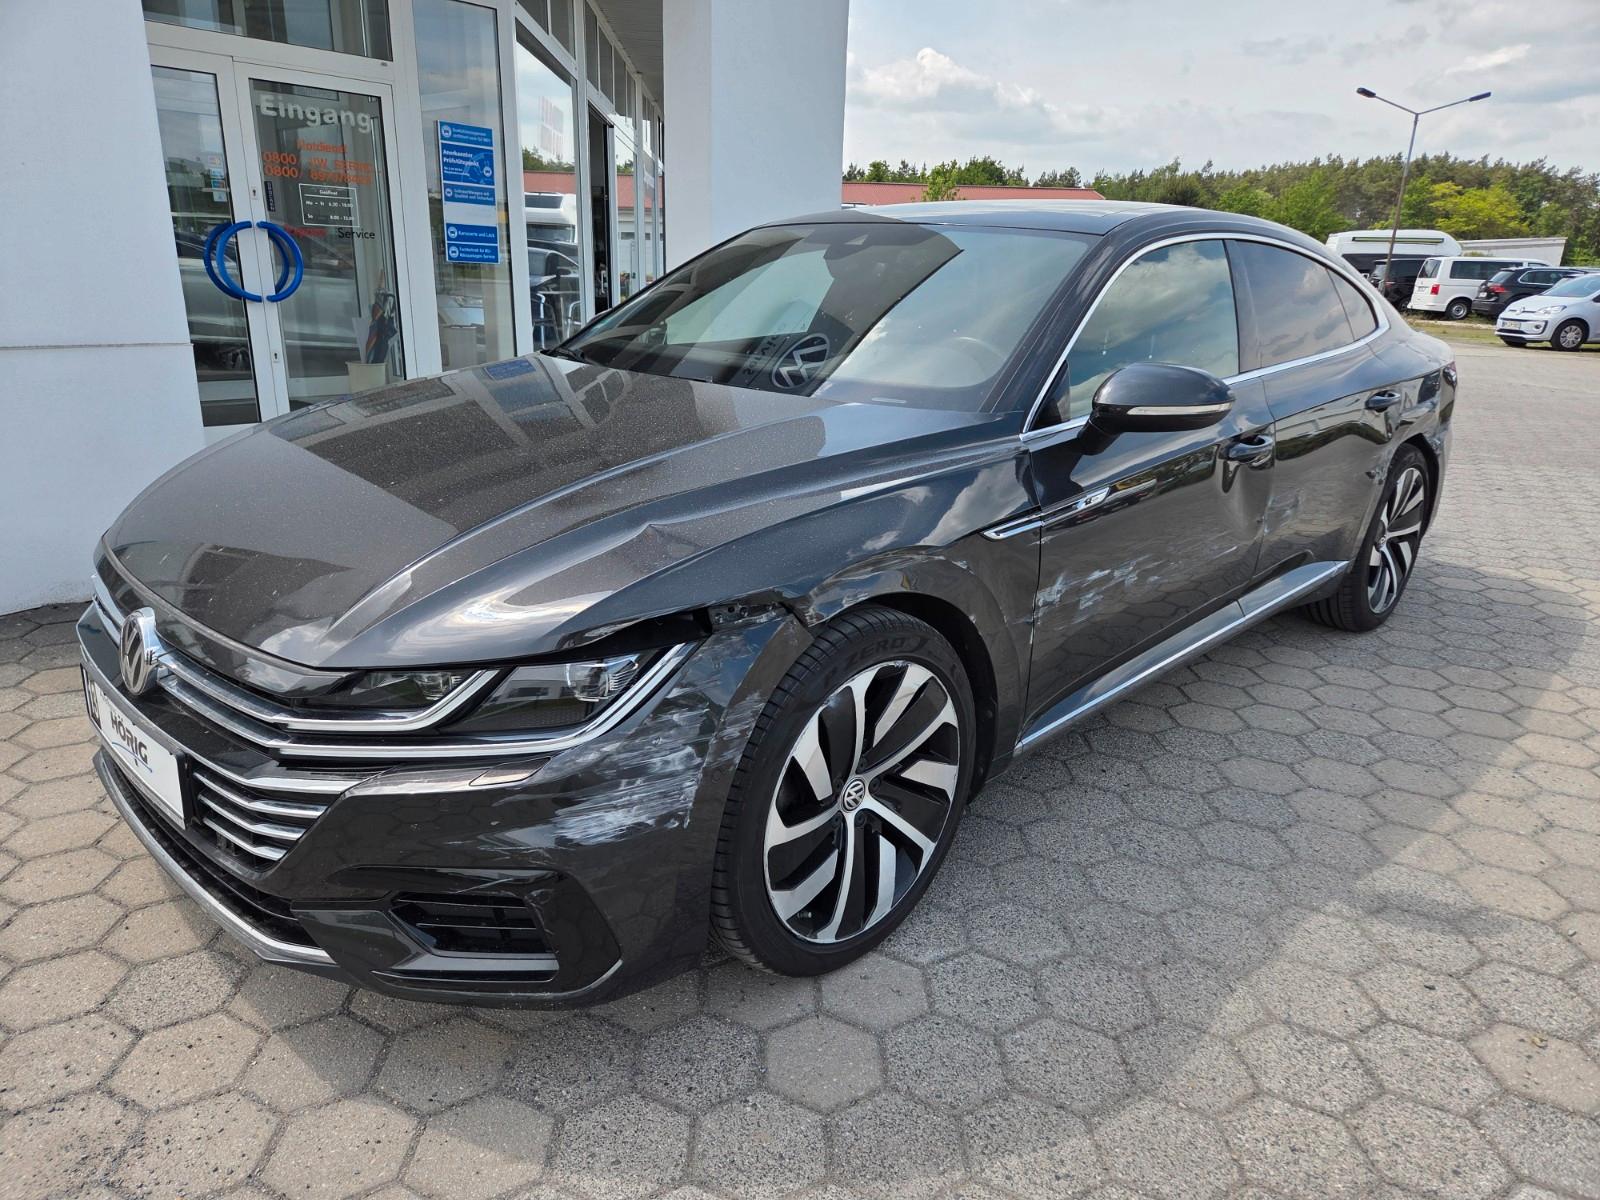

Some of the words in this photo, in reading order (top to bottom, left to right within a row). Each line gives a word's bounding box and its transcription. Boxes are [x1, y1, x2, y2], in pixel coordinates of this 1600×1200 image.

[260, 93, 371, 134] Eingang
[337, 227, 376, 240] Service
[110, 711, 148, 764] HÖRIG
